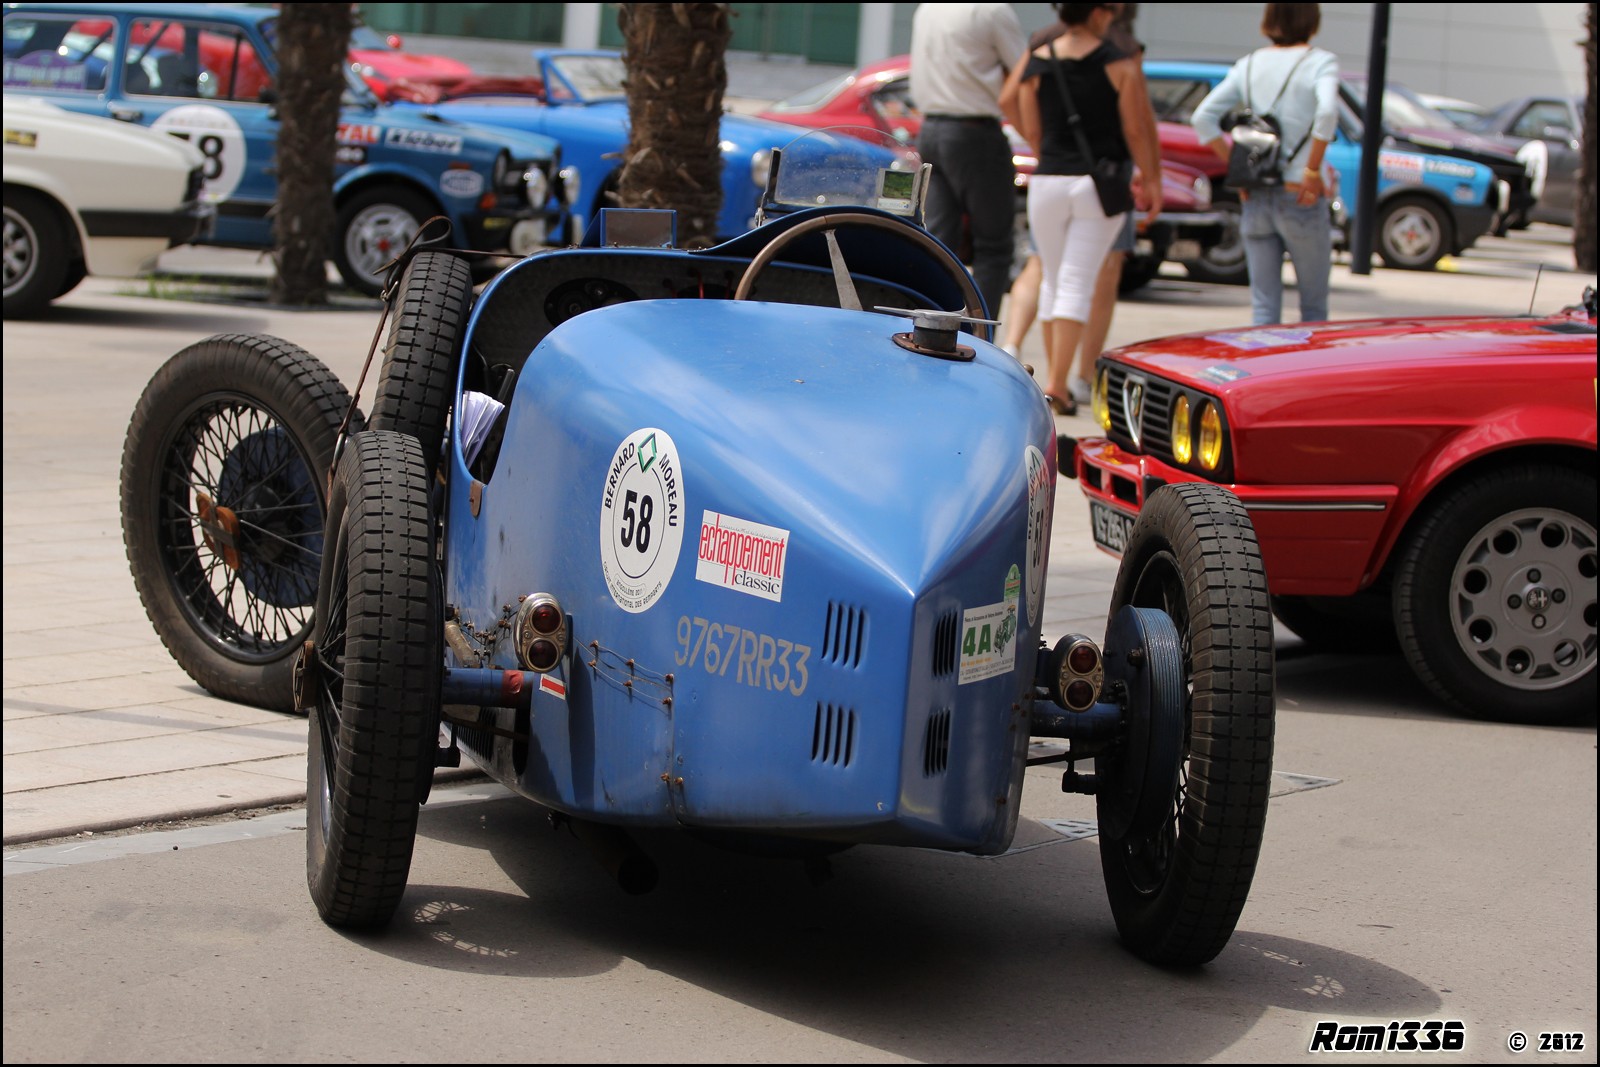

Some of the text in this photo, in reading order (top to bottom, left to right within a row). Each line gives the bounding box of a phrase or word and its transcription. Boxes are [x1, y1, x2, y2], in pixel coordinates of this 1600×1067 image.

[604, 441, 678, 528] BERNARD MOREAU
[619, 488, 654, 554] 58
[698, 513, 785, 585] echappement
[734, 570, 781, 595] classic
[673, 615, 812, 697] 9767RR33
[961, 623, 992, 657] 4A
